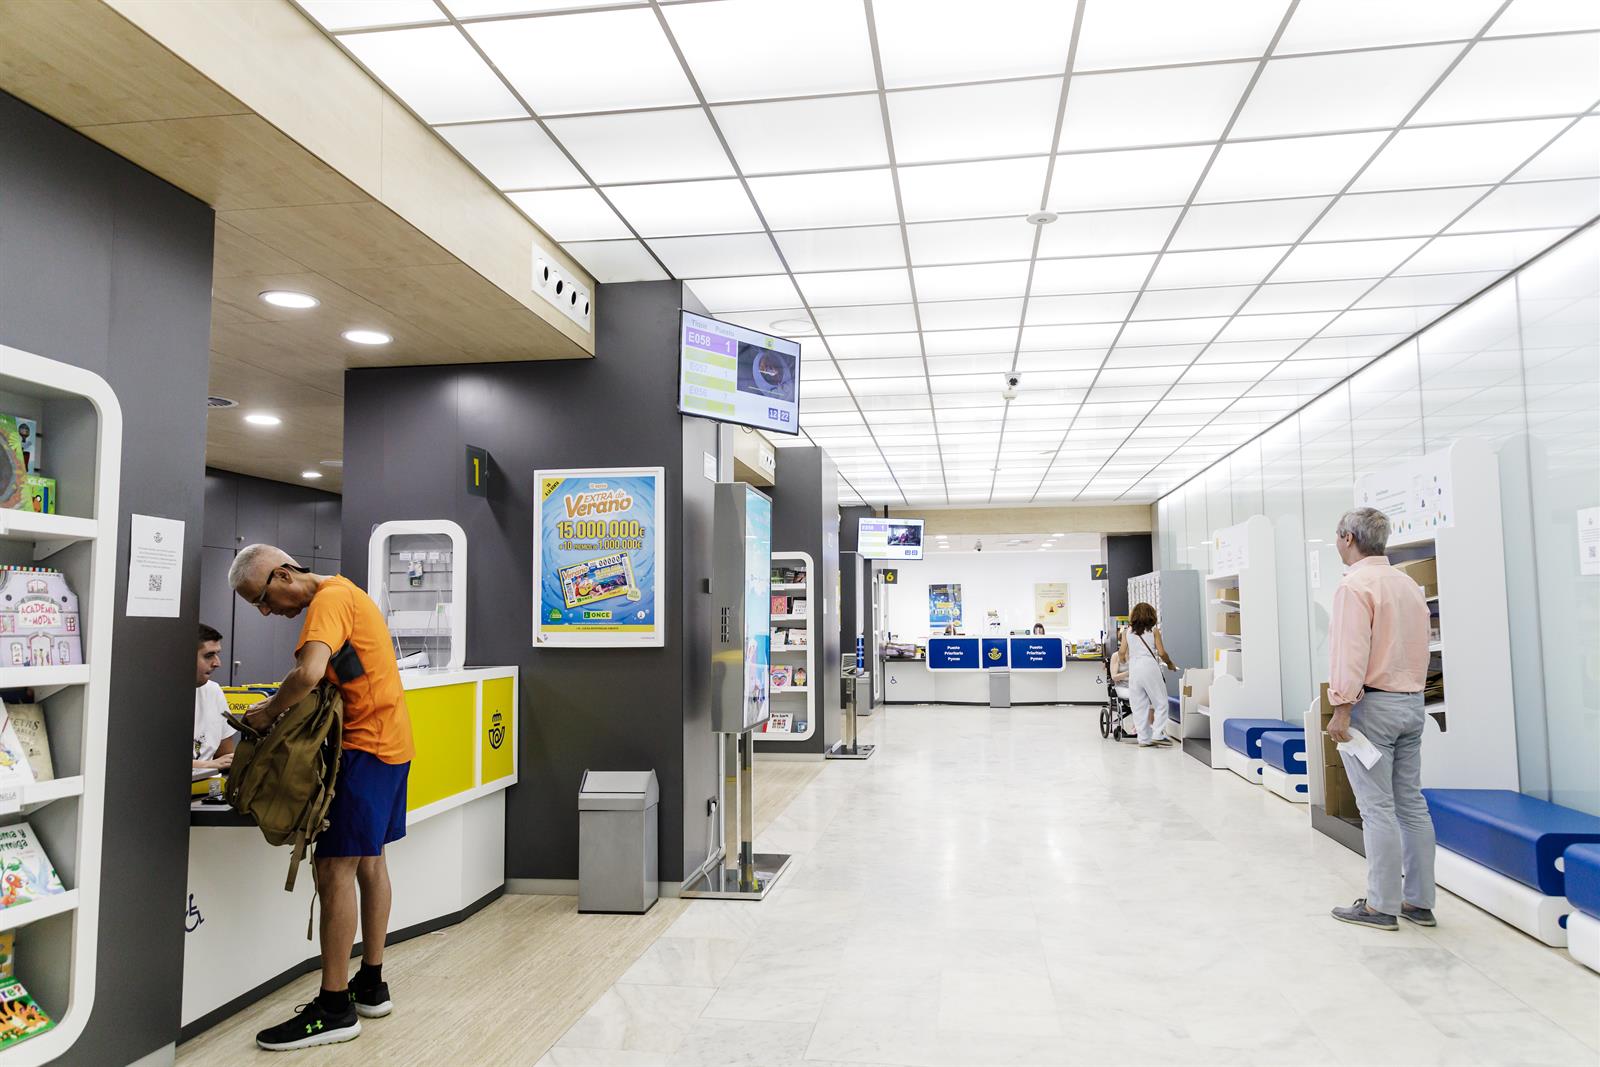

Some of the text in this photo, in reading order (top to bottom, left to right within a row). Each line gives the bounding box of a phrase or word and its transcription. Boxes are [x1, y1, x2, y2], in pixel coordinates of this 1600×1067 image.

[688, 332, 731, 353] E058 1
[474, 458, 480, 486] 1
[584, 489, 625, 503] EXTRA de
[565, 494, 632, 518] Verano
[557, 520, 645, 539] 15.000.000€
[563, 541, 572, 550] 10
[598, 539, 643, 551] 1.000.000€
[886, 572, 894, 582] 6
[1095, 567, 1103, 577] 7
[21, 603, 57, 614] ACADEMIA
[32, 615, 52, 625] MODA
[0, 839, 28, 851] rmiga
